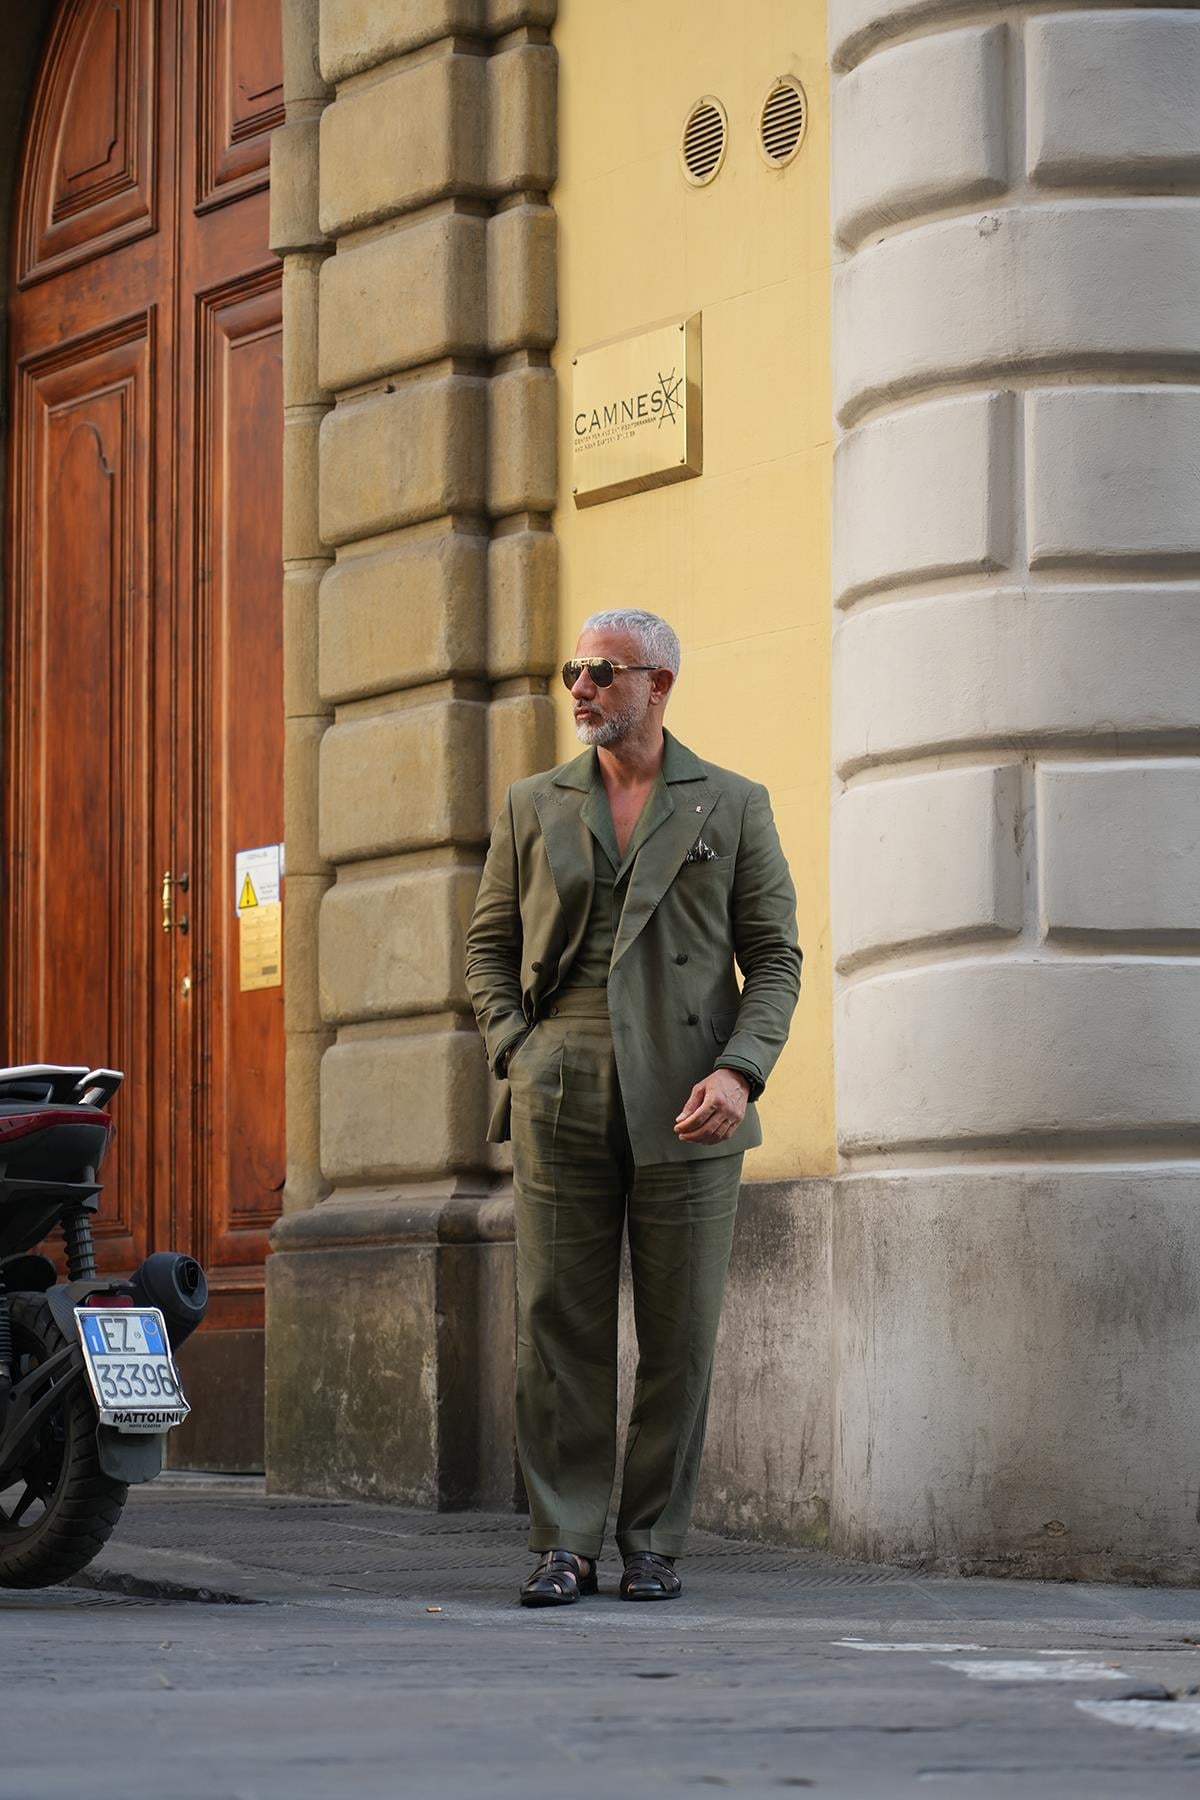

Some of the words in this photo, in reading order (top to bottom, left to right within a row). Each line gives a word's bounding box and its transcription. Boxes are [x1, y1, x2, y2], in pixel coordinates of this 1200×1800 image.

[574, 390, 662, 435] CAMNES
[99, 1318, 136, 1351] EZ
[97, 1364, 175, 1398] 33396
[113, 1412, 178, 1423] MATTOLINI
